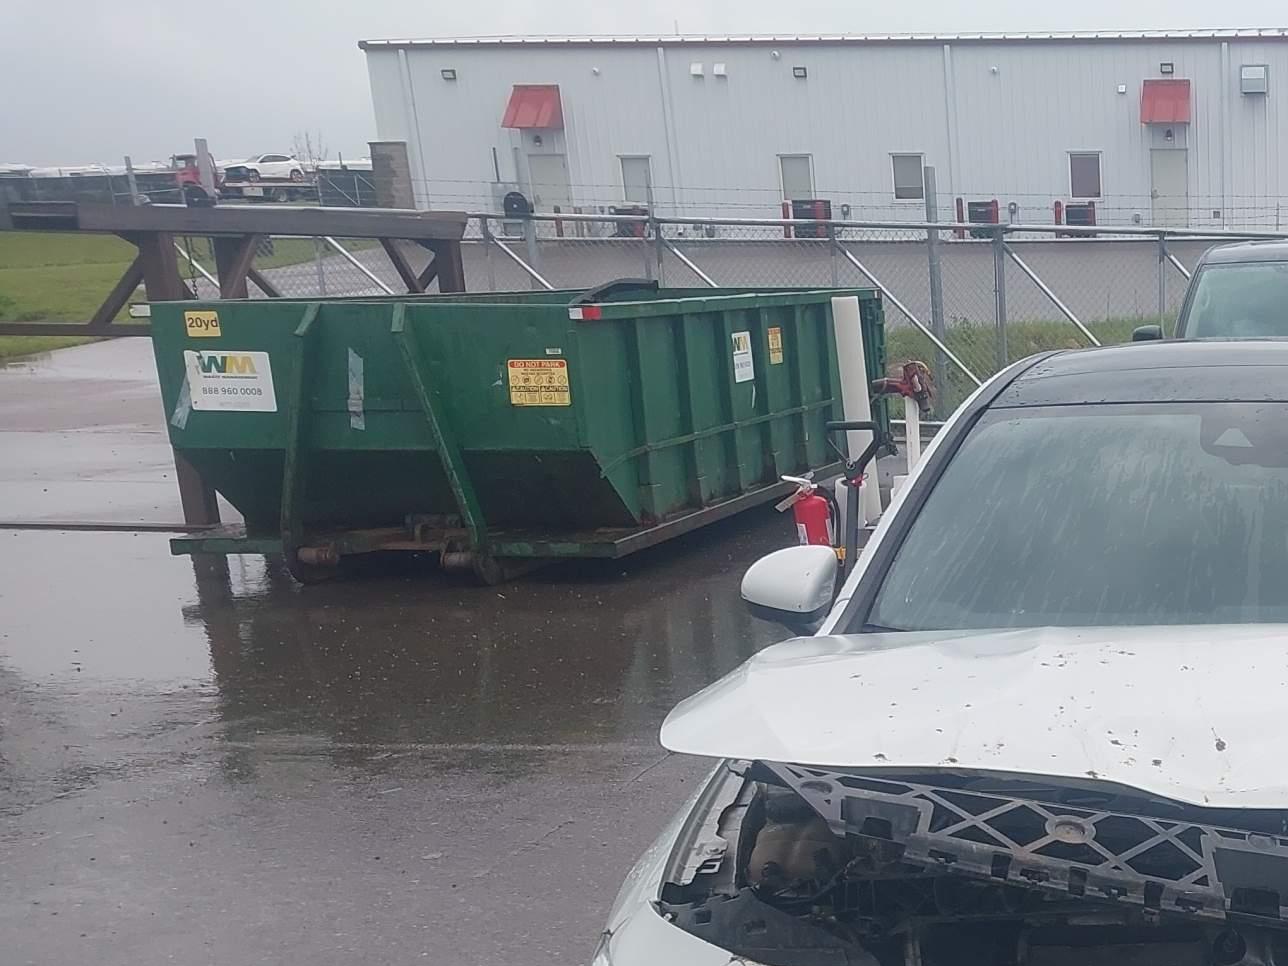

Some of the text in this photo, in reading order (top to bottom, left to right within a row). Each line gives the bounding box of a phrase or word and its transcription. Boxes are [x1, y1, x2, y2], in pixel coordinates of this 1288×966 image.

[188, 317, 218, 330] 20yd
[196, 355, 256, 374] WM
[202, 386, 263, 396] 888 960 0008
